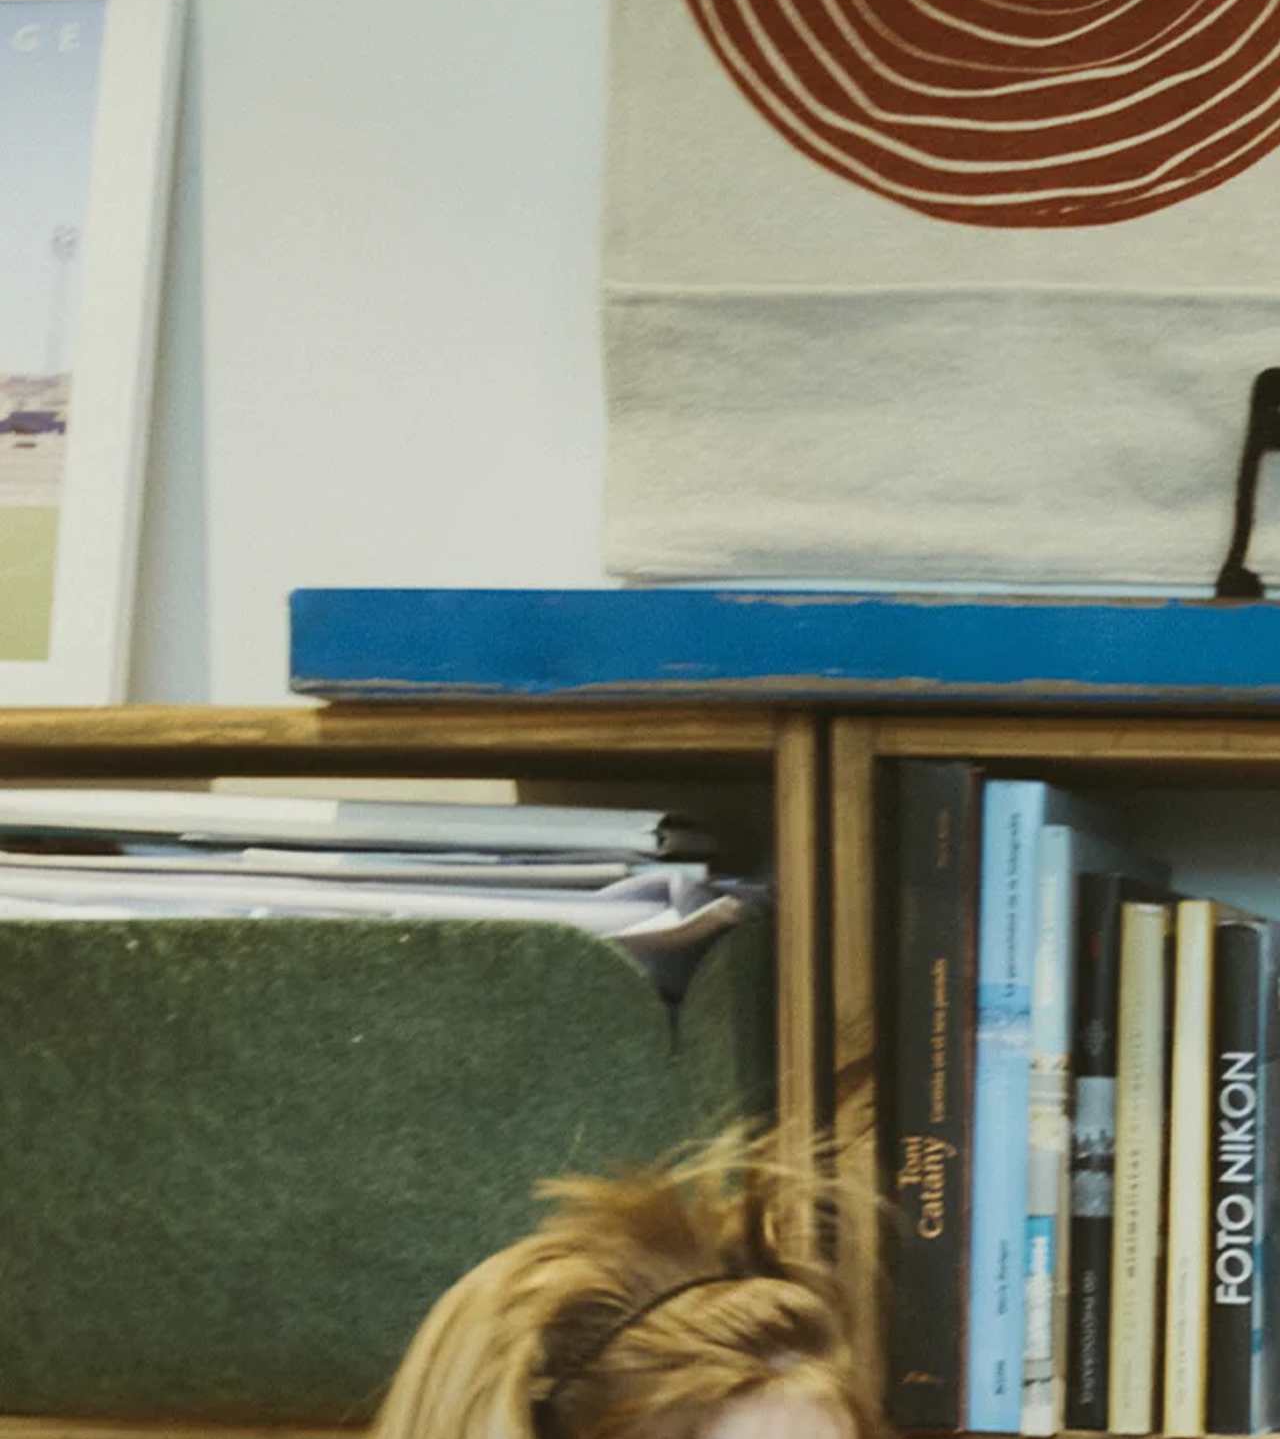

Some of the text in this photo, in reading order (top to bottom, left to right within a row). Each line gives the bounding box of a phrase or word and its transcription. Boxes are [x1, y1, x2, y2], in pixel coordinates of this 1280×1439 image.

[897, 1137, 922, 1189] Toni
[914, 1138, 958, 1240] Catany
[1215, 1052, 1256, 1305] FOTO NIKON
